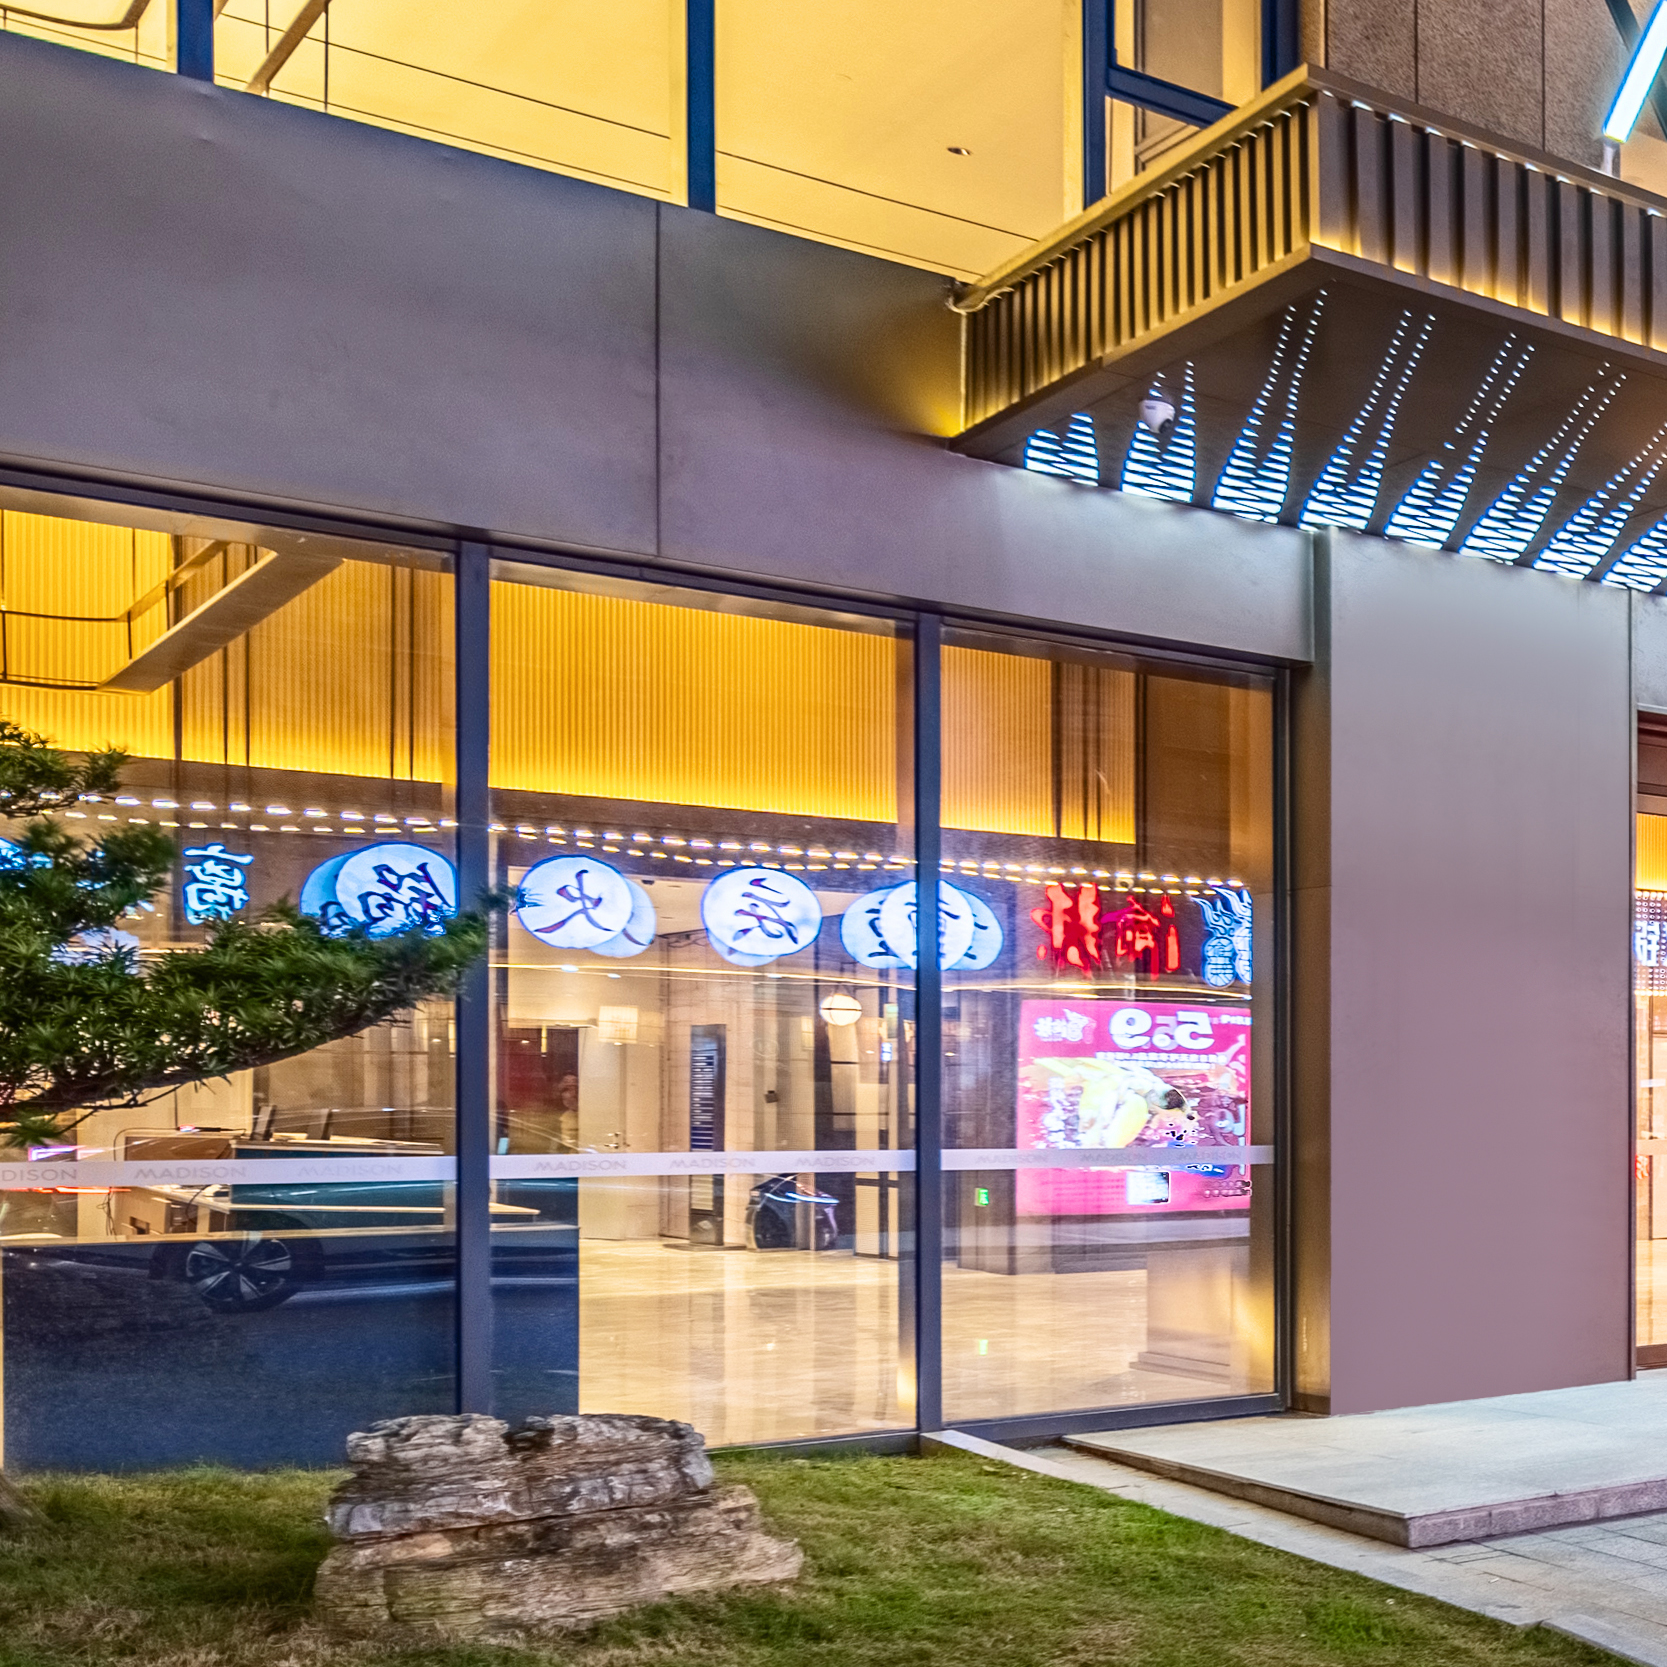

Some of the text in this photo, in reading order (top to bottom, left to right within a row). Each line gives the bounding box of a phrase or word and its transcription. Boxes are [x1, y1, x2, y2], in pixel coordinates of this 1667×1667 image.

[668, 1157, 756, 1170] MADISON
[793, 1156, 876, 1168] MADISON
[974, 1152, 1049, 1164] MADISON
[297, 1163, 402, 1178] MADISON
[534, 1159, 627, 1172] MADISON
[134, 1166, 246, 1180] MADISON
